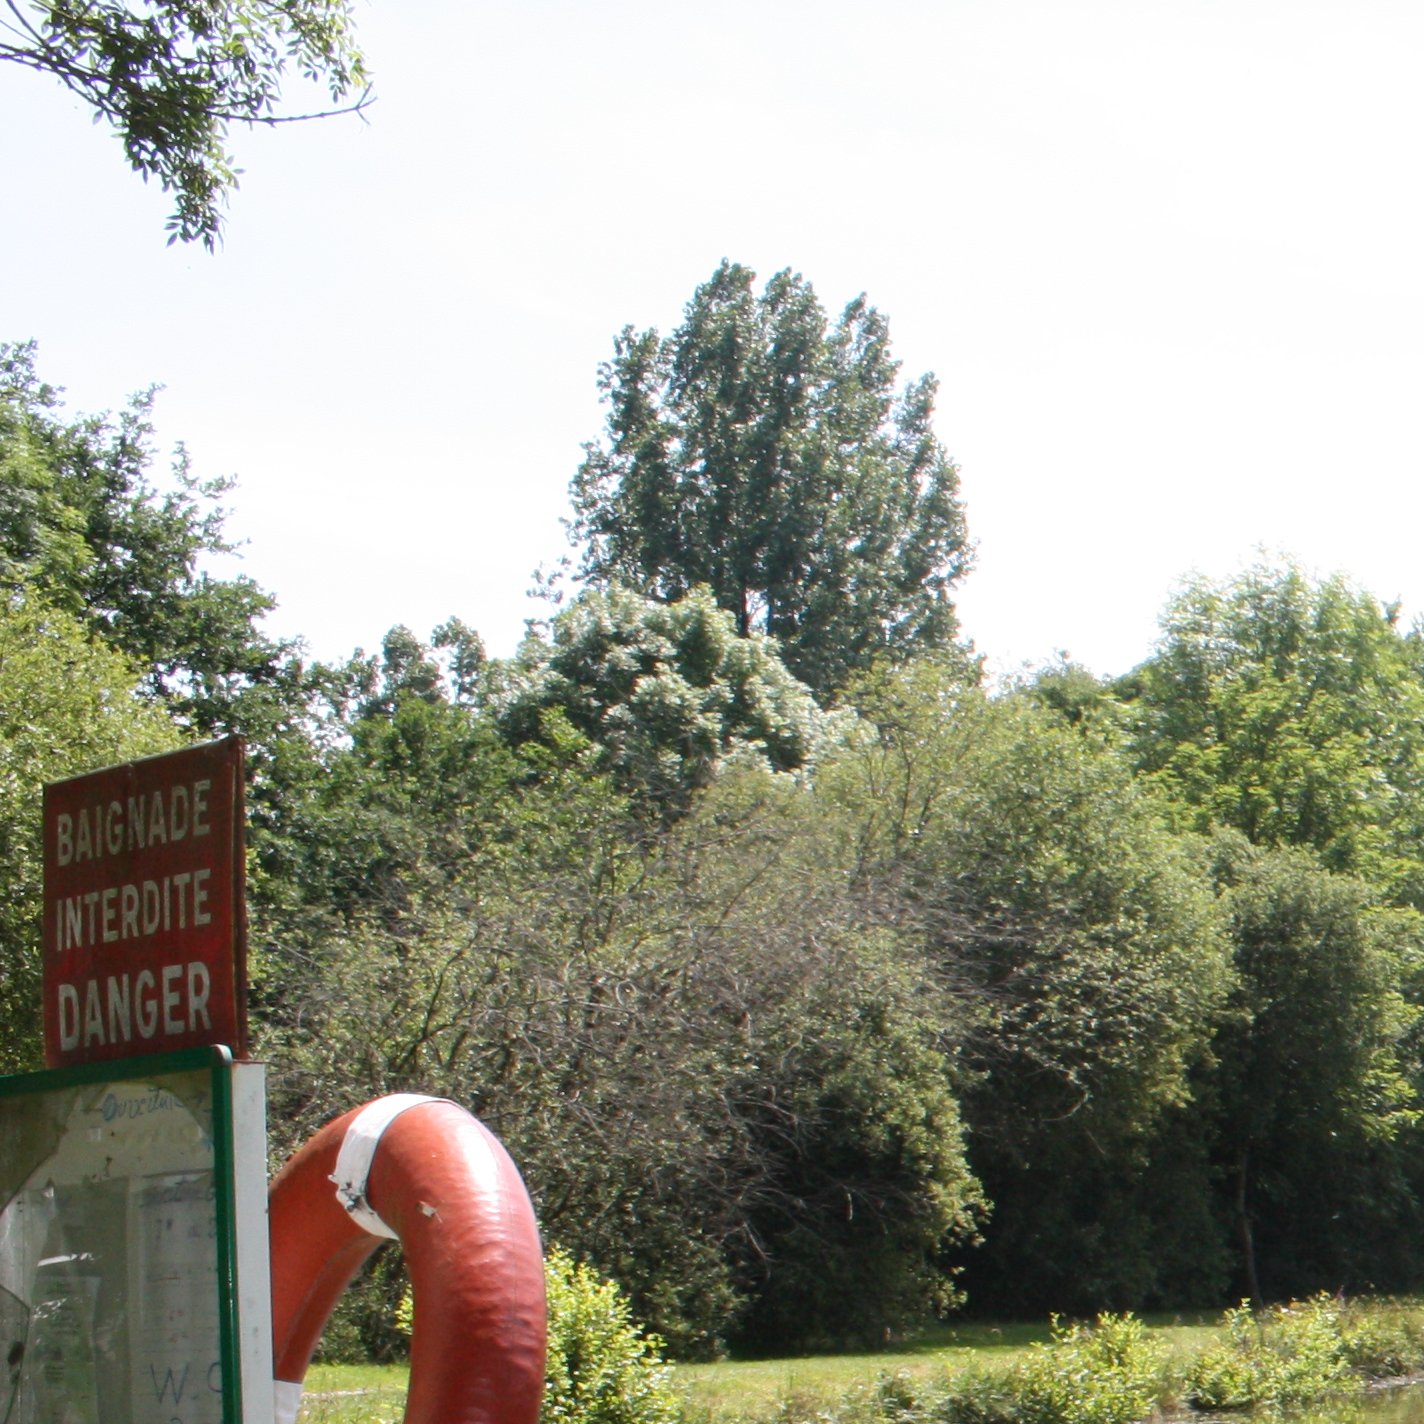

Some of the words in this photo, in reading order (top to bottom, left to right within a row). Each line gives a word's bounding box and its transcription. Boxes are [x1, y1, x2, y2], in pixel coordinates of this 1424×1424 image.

[57, 779, 211, 867] BAIGNADE
[57, 868, 211, 951] INTERDITE
[58, 961, 212, 1051] DANGER
